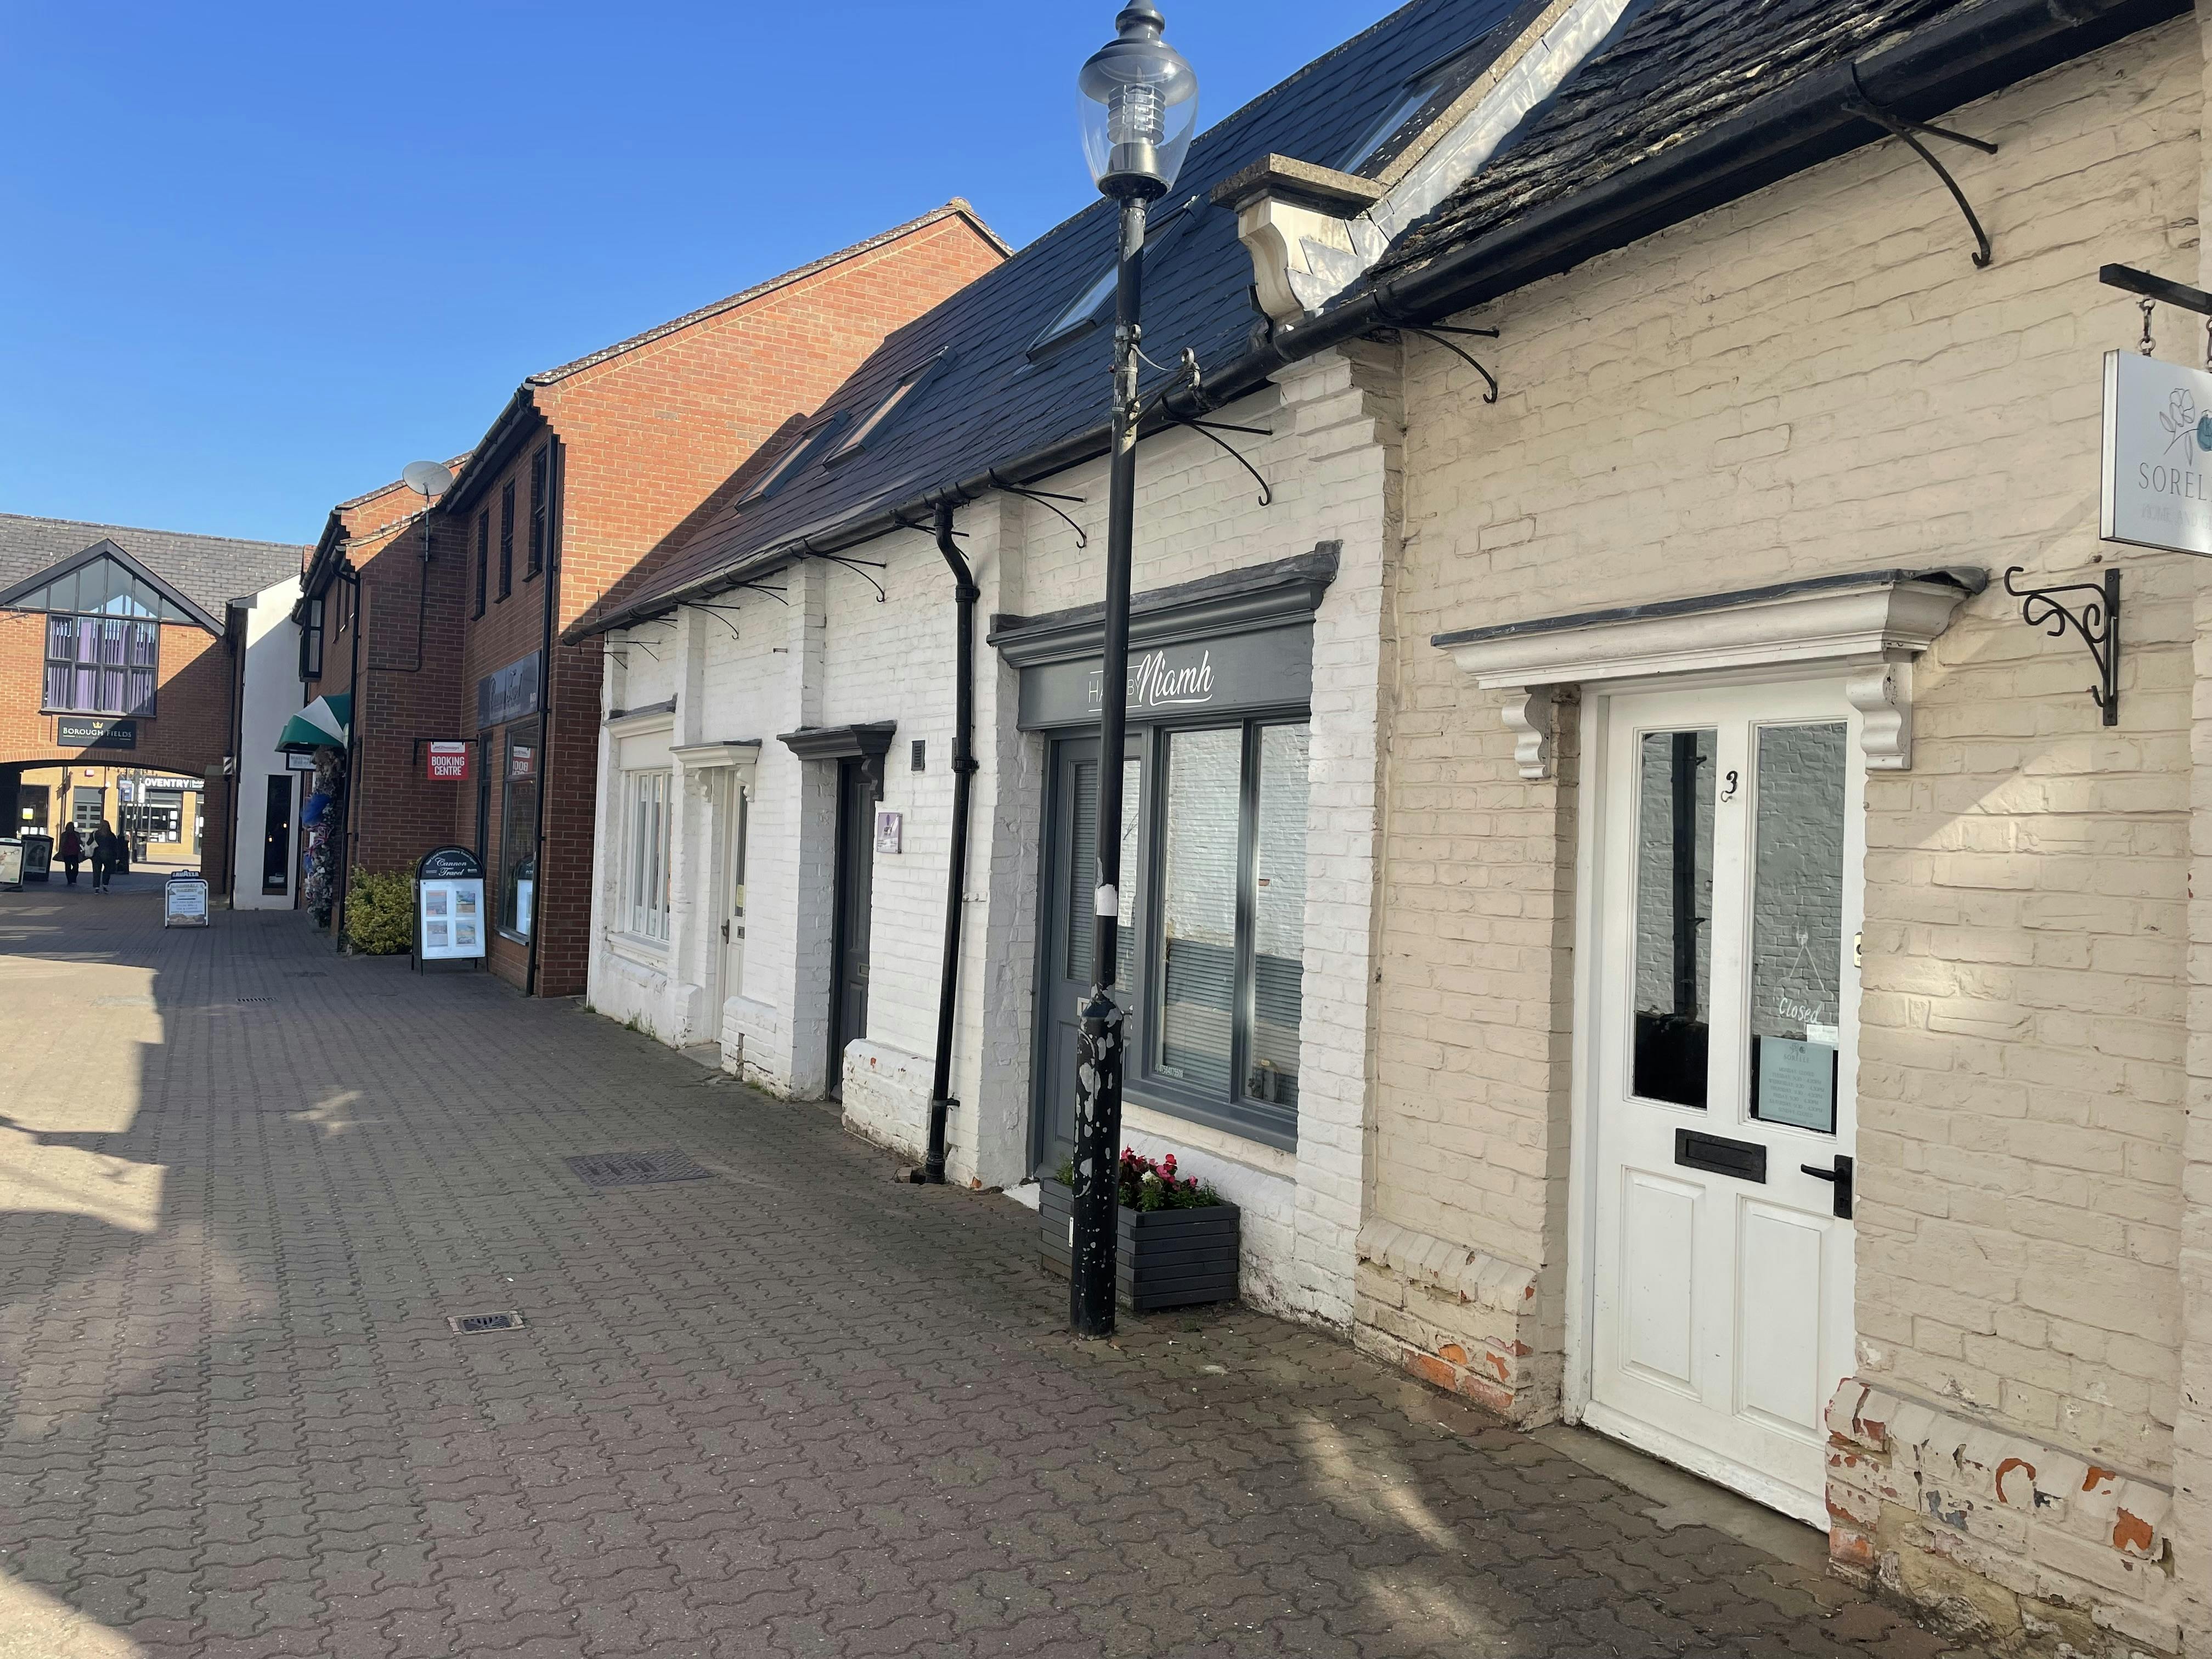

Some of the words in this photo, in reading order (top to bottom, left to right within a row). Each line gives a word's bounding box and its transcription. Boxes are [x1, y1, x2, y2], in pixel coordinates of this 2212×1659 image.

[2138, 462, 2212, 502] SOREL
[1137, 650, 1215, 706] Niamh
[63, 727, 103, 736] BOROUGH
[431, 756, 465, 766] BOOKING
[434, 766, 462, 776] CENTRE
[1722, 771, 1737, 800] 3
[435, 857, 467, 866] Cannon
[438, 867, 465, 876] Travel
[1779, 997, 1823, 1024] Closed
